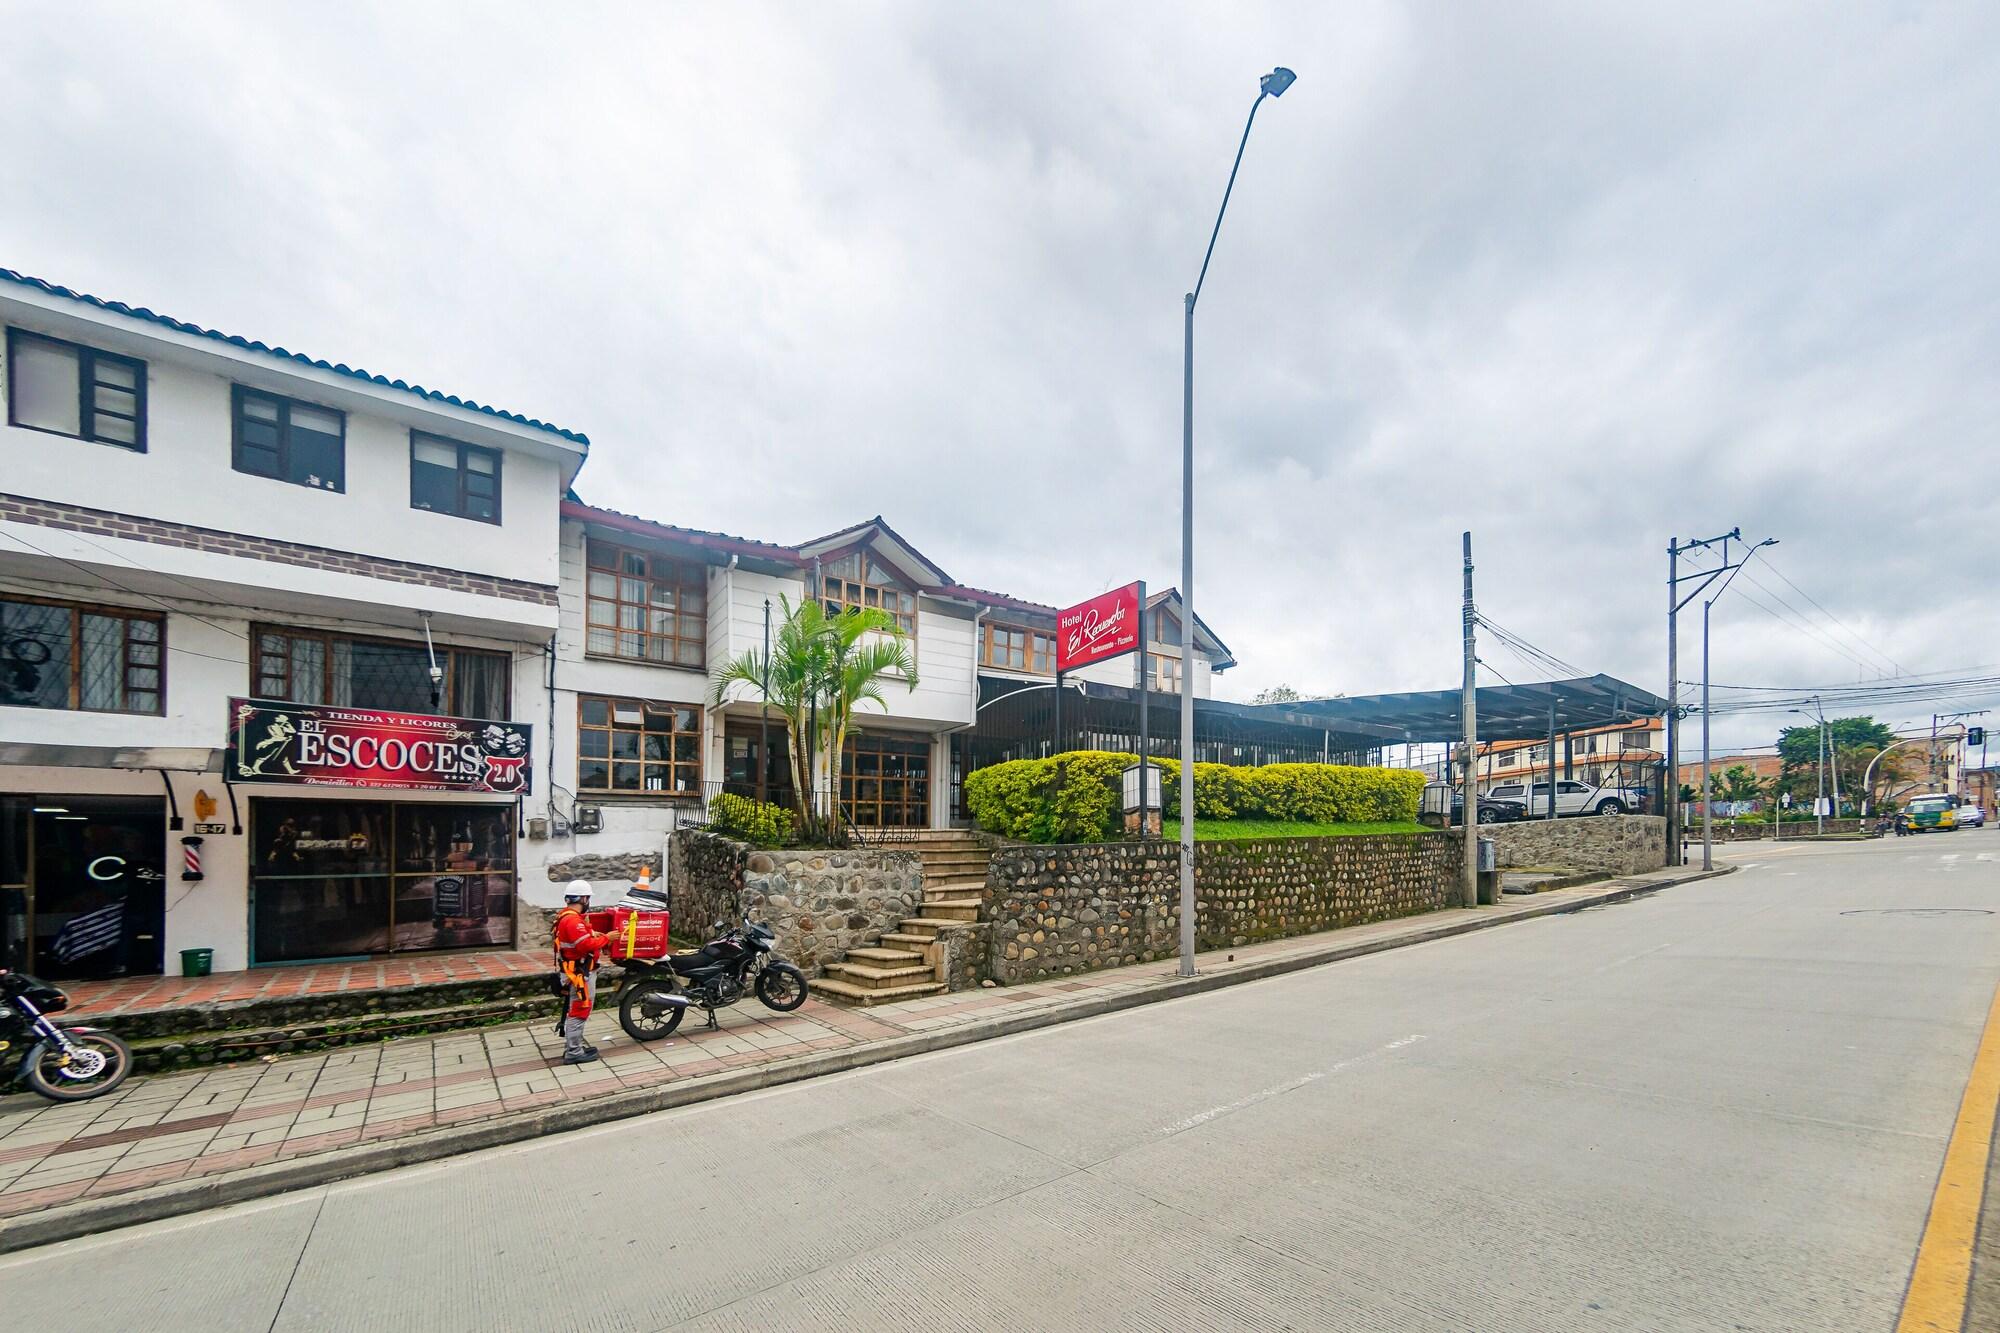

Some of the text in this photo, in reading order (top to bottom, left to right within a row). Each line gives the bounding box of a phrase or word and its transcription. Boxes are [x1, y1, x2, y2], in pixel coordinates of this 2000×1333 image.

[1061, 611, 1082, 628] Hotel
[299, 720, 327, 733] EL
[327, 711, 384, 722] TIENDA
[400, 718, 457, 729] LICORES
[296, 732, 481, 776] ESCOCES
[493, 764, 515, 783] 2.0
